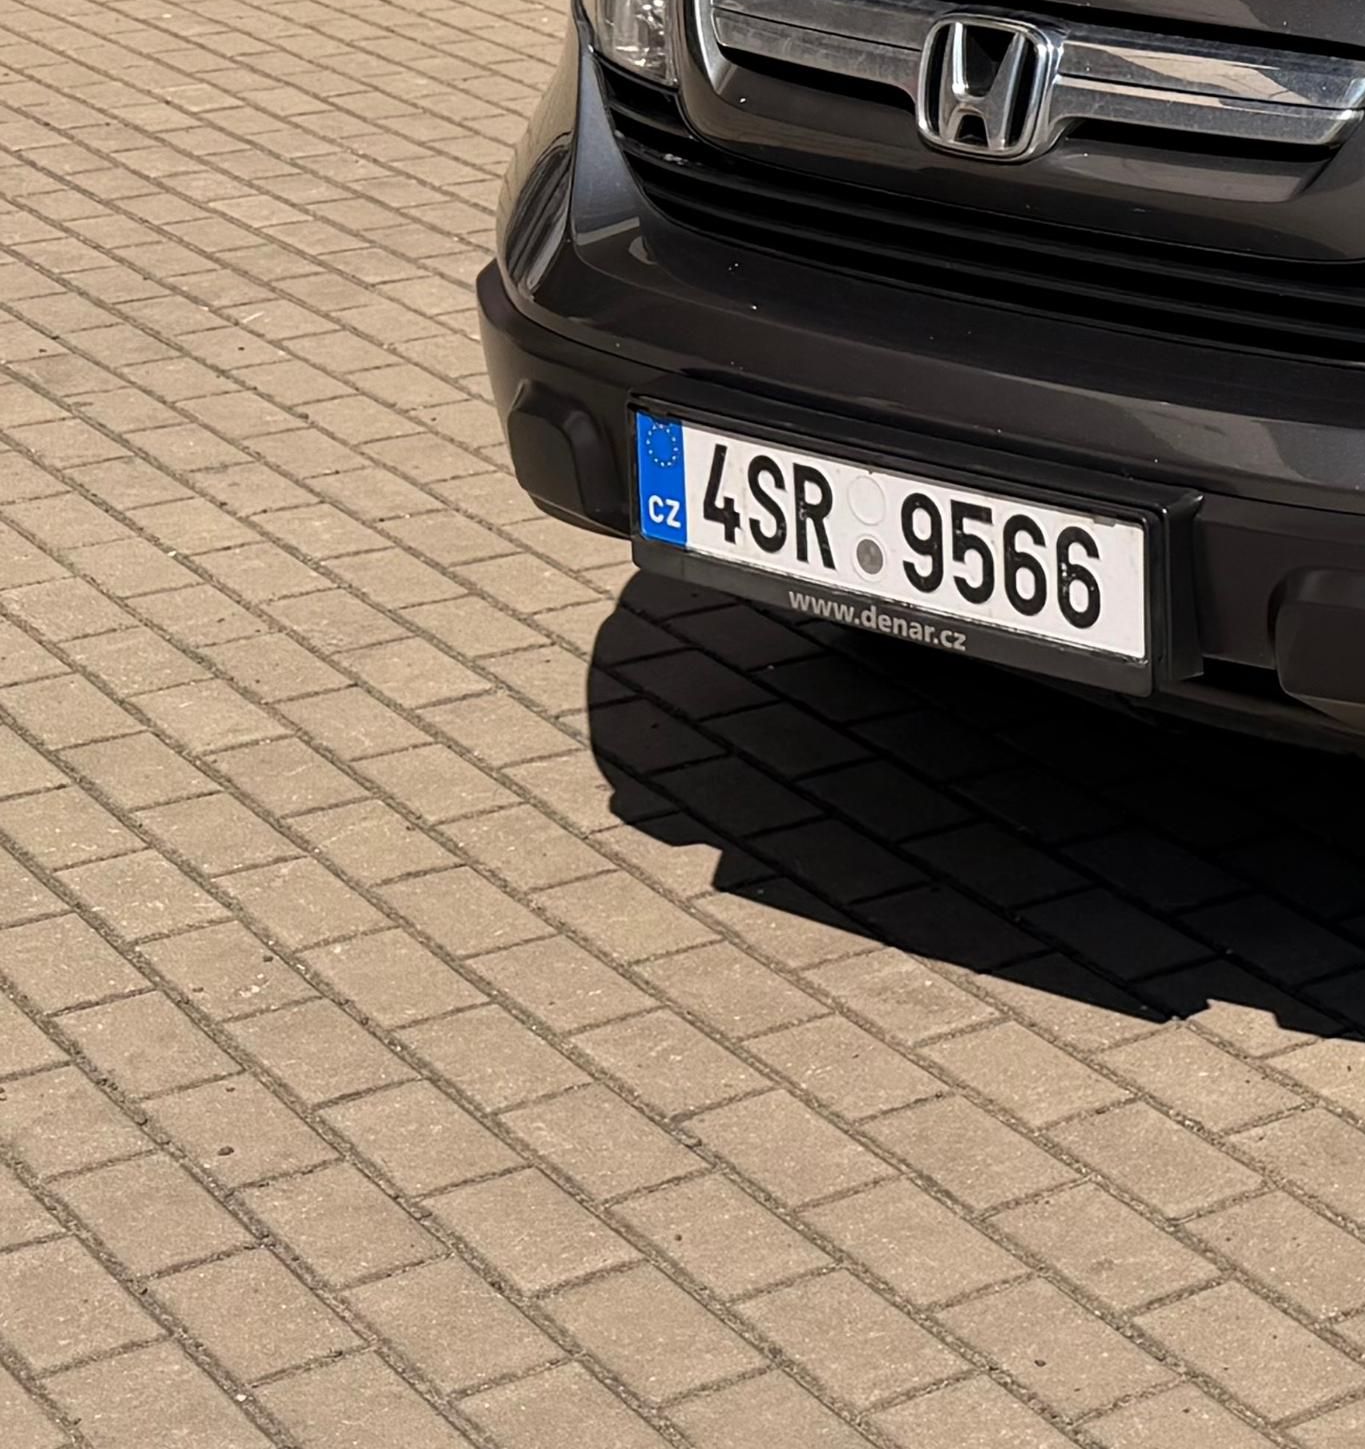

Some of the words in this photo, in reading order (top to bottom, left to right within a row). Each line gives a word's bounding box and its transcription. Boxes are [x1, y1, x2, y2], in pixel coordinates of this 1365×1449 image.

[648, 494, 682, 528] CZ
[702, 443, 837, 571] 4SR
[899, 491, 1102, 630] 9566
[788, 590, 967, 651] www.denar.cz
